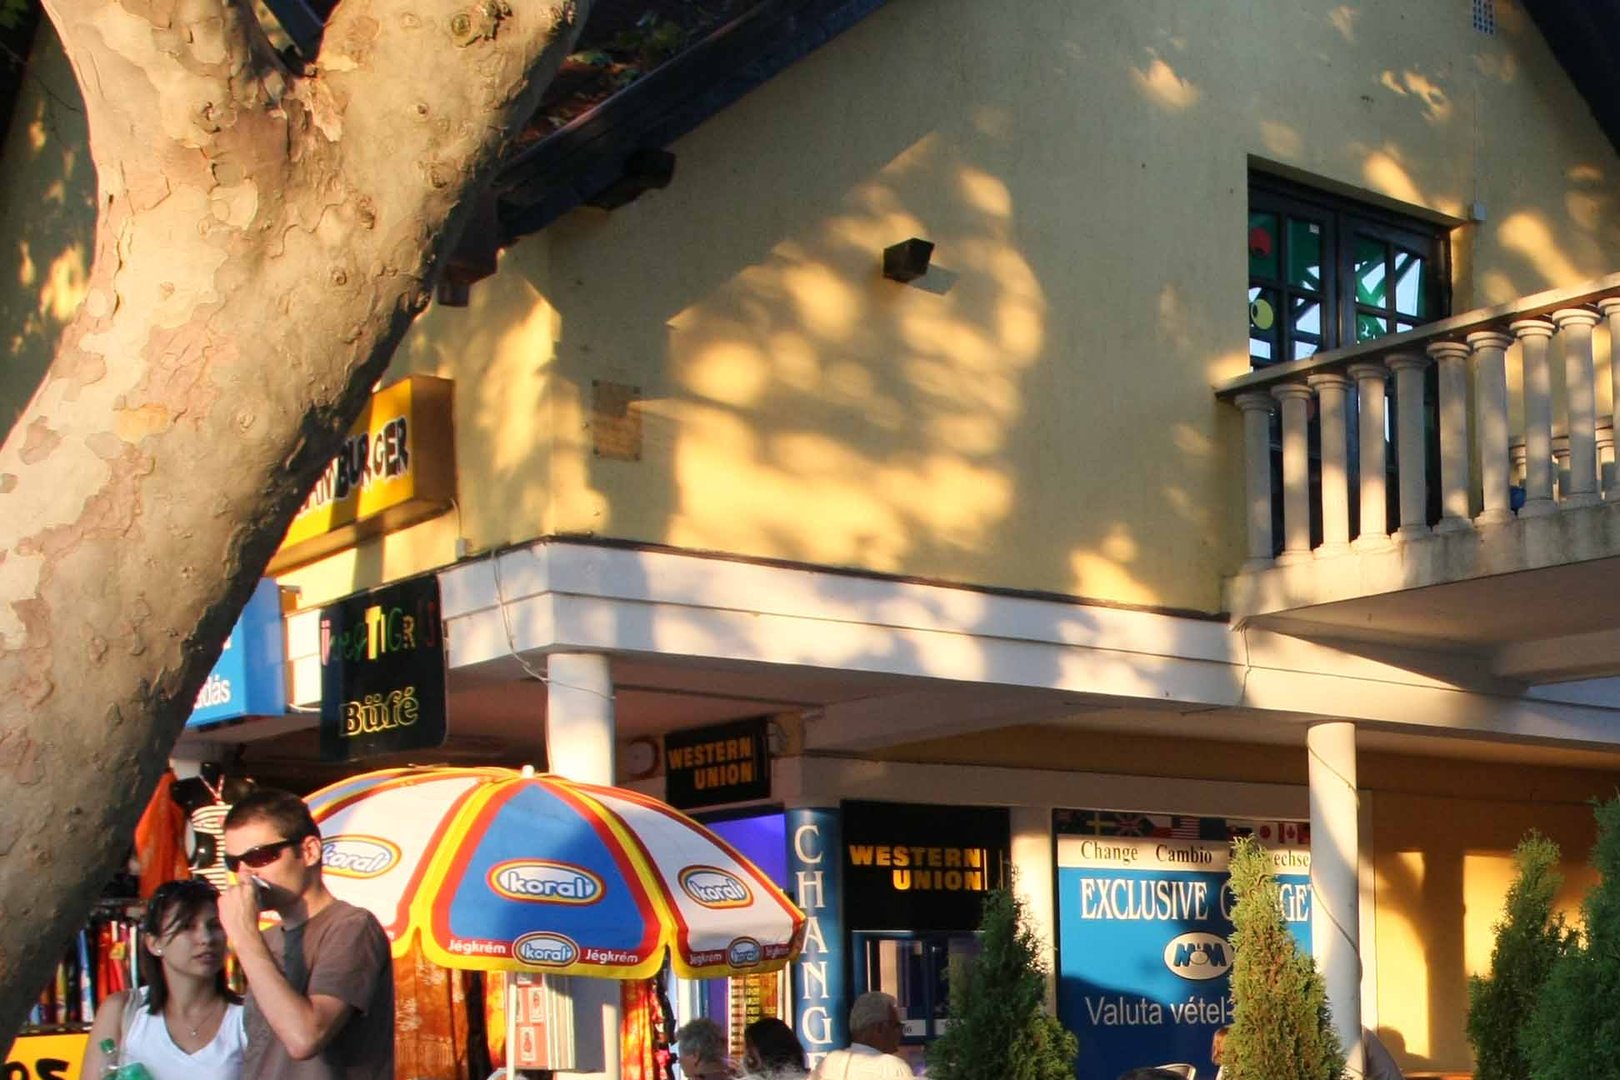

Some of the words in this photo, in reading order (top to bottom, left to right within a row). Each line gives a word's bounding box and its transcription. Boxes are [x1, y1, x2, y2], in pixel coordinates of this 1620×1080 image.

[338, 686, 420, 738] Büfé
[668, 736, 751, 770] WESTERN
[694, 760, 753, 790] UNION
[850, 844, 981, 869] WESTERN
[1080, 840, 1139, 865] Change
[1155, 843, 1213, 865] Cambio
[506, 870, 588, 900] koral
[892, 869, 982, 892] UNION
[1080, 877, 1208, 922] EXCLUSIVE
[448, 939, 506, 957] Jégkrém
[584, 949, 639, 966] Jégkrém
[1084, 996, 1163, 1026] Valuta
